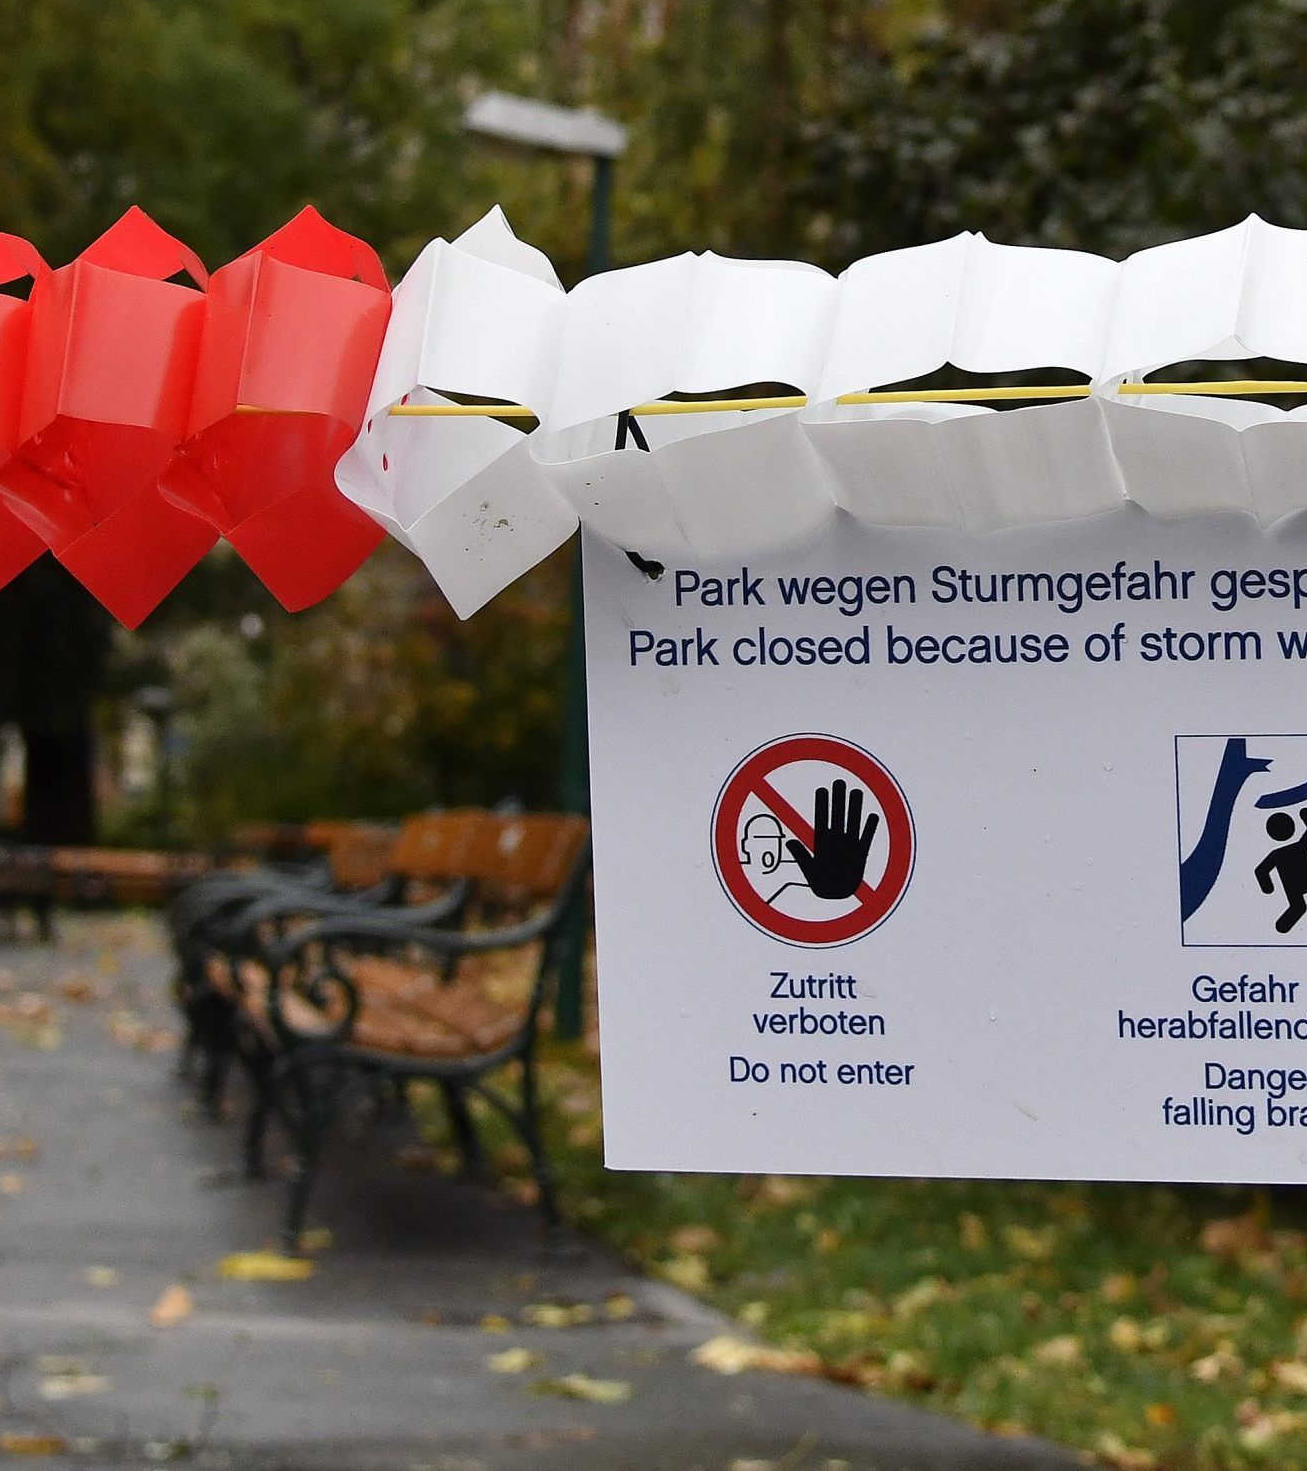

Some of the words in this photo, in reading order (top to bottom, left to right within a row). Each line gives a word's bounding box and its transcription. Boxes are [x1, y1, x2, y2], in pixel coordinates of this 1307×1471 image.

[675, 566, 767, 607] Park
[777, 575, 916, 617] wegen
[931, 559, 1196, 614] Sturmgefahr
[629, 627, 720, 667] Park
[732, 625, 871, 666] closed
[886, 624, 1070, 665] because
[1084, 622, 1126, 663] of
[1139, 627, 1262, 662] storm
[769, 971, 858, 1000] Zutritt
[1191, 973, 1300, 1004] Gefahr
[752, 1005, 886, 1036] verboten
[729, 1055, 770, 1084] Do
[780, 1059, 828, 1084] not
[836, 1060, 916, 1086] enter
[1161, 1096, 1256, 1136] falling
